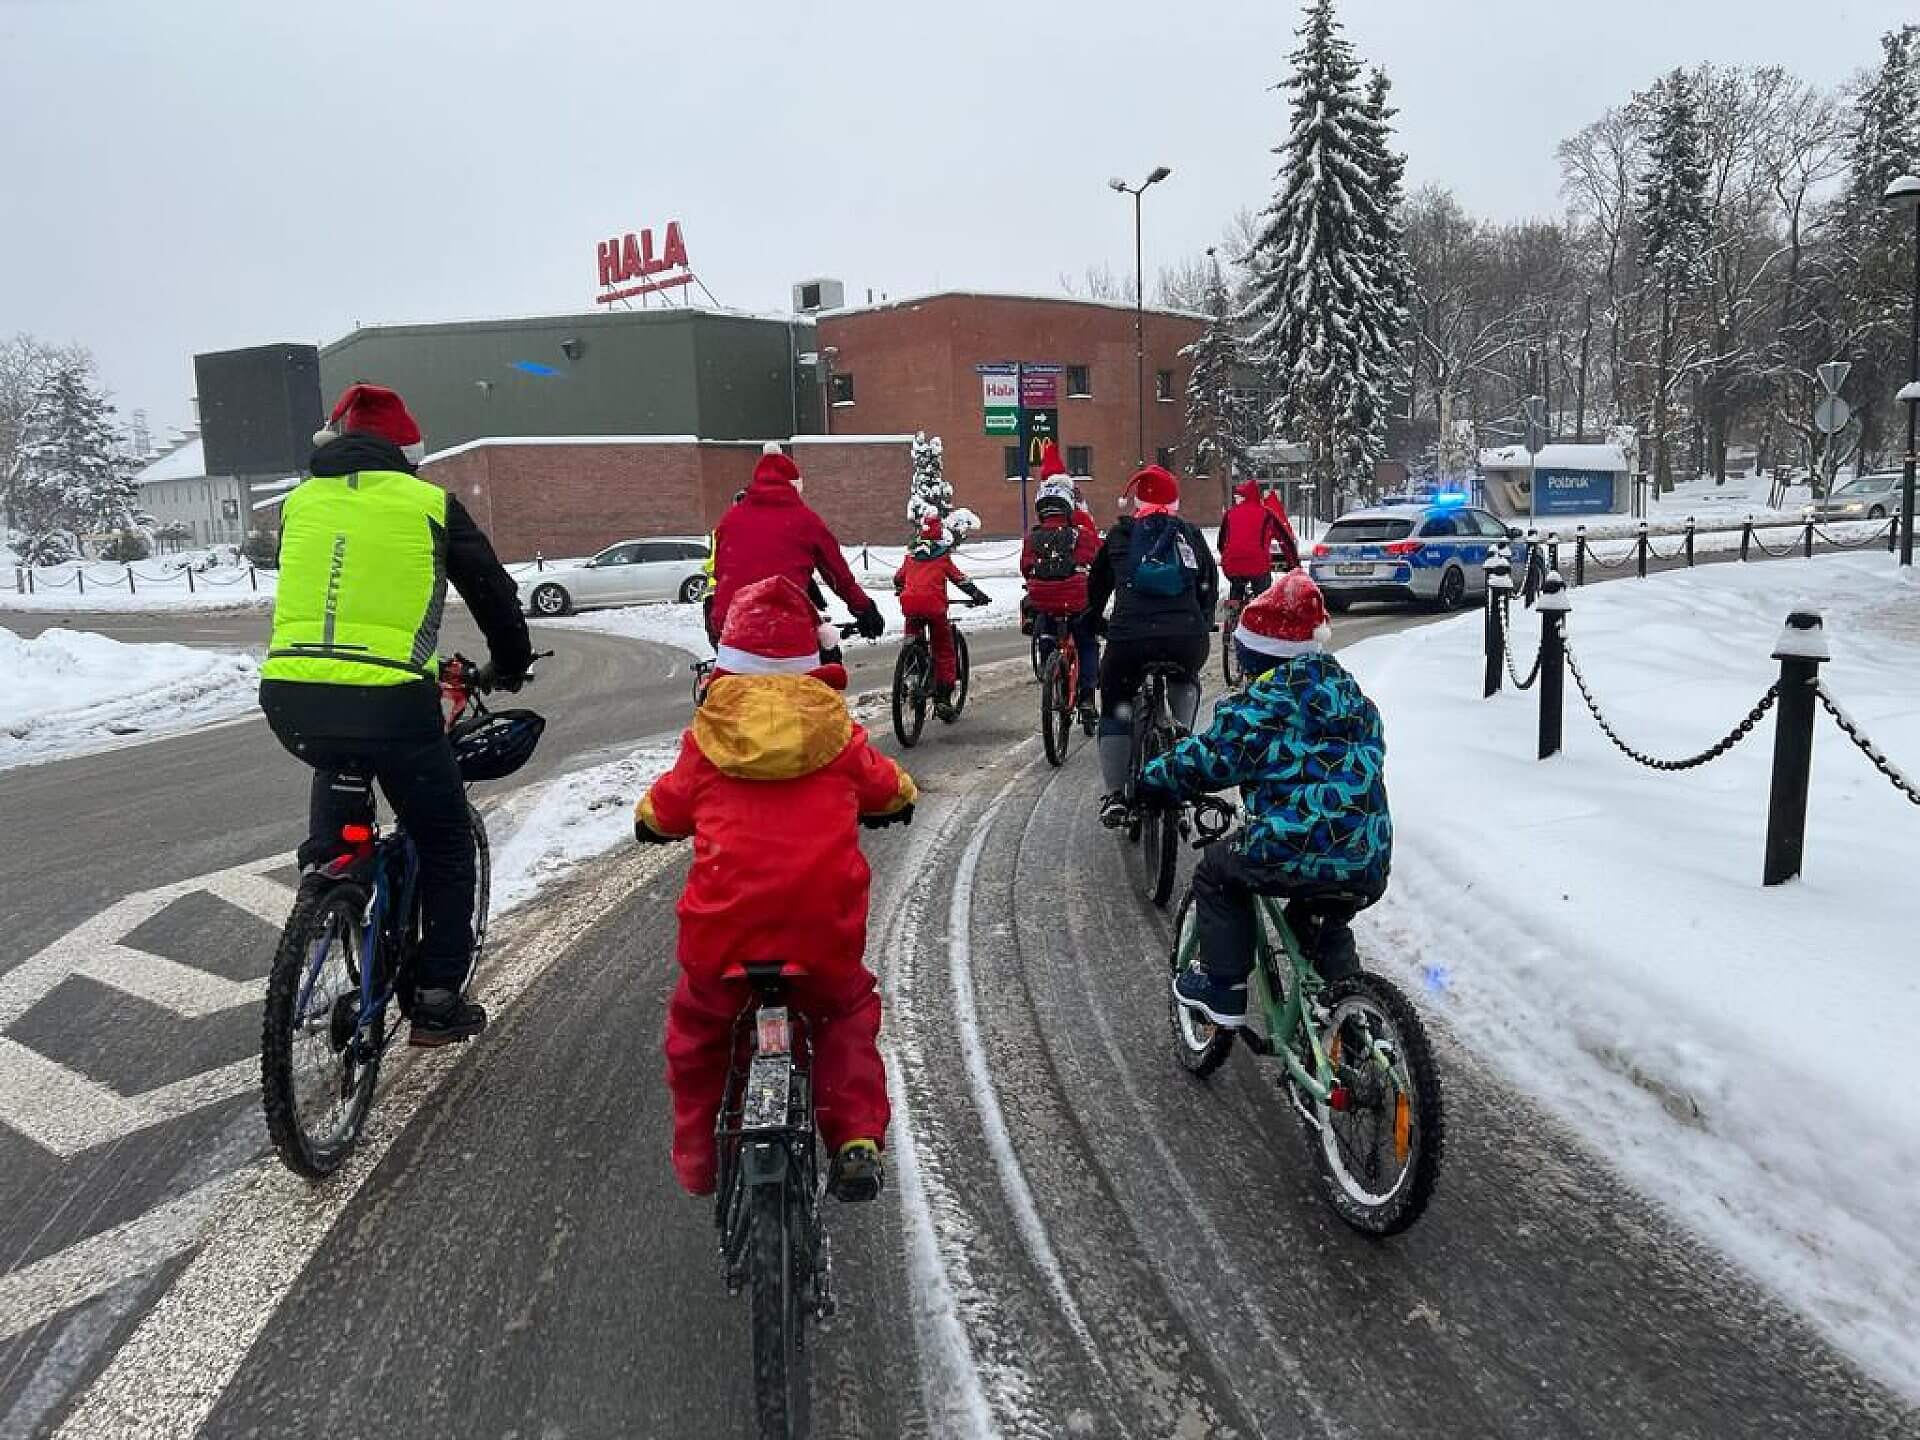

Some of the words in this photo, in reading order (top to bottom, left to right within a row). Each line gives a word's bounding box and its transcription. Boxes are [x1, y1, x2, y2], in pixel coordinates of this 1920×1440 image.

[598, 222, 688, 286] HALA
[986, 383, 1015, 397] Hala
[1547, 475, 1589, 489] Polbruk
